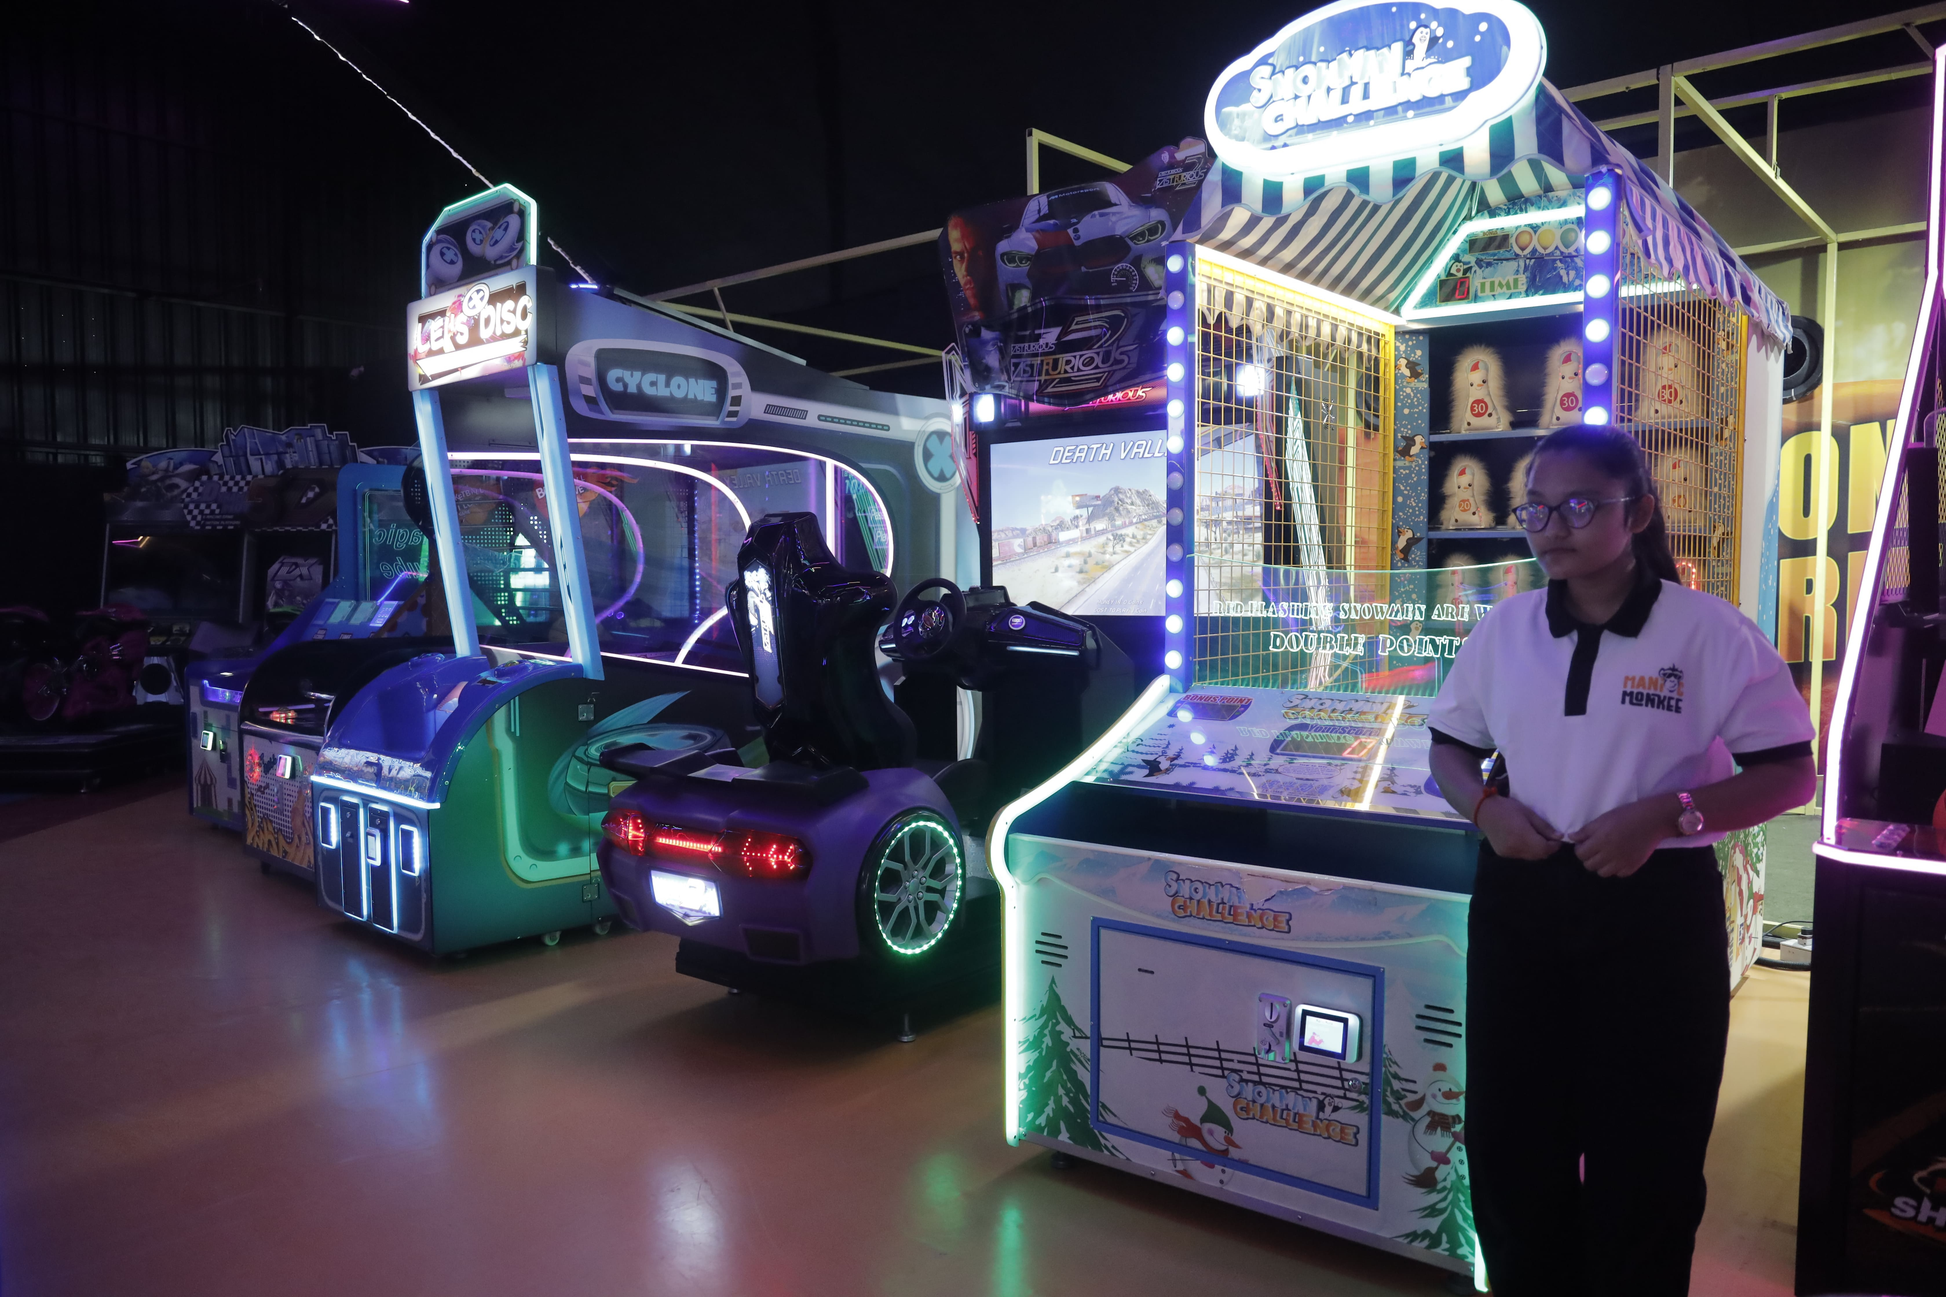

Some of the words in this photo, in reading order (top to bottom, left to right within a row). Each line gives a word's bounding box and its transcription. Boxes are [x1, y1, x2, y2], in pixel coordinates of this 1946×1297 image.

[1249, 41, 1404, 109] SNOWMAN
[1261, 55, 1472, 136] CHALLENGE
[1477, 275, 1527, 296] TIME
[479, 294, 533, 340] DISC
[1041, 344, 1139, 380] FURIOUS
[606, 368, 718, 402] CYCLONE
[1470, 403, 1487, 414] 30
[1562, 396, 1576, 407] 30
[1049, 443, 1115, 466] DEATH
[1119, 438, 1167, 461] VALL
[1459, 501, 1471, 510] 20
[1213, 600, 1245, 617] RED
[1248, 600, 1334, 620] FLASHING
[1339, 602, 1427, 621] SNOWMEN
[1431, 603, 1470, 622] ARE
[1269, 631, 1366, 656] DOUBLE
[1182, 693, 1219, 703] BONUS
[1219, 696, 1254, 706] POINT
[1620, 690, 1683, 715] MONKEE
[1170, 896, 1292, 934] CHALLENGE
[1226, 1070, 1320, 1119] SNOWMAN
[1232, 1097, 1360, 1147] CHALLENGE
